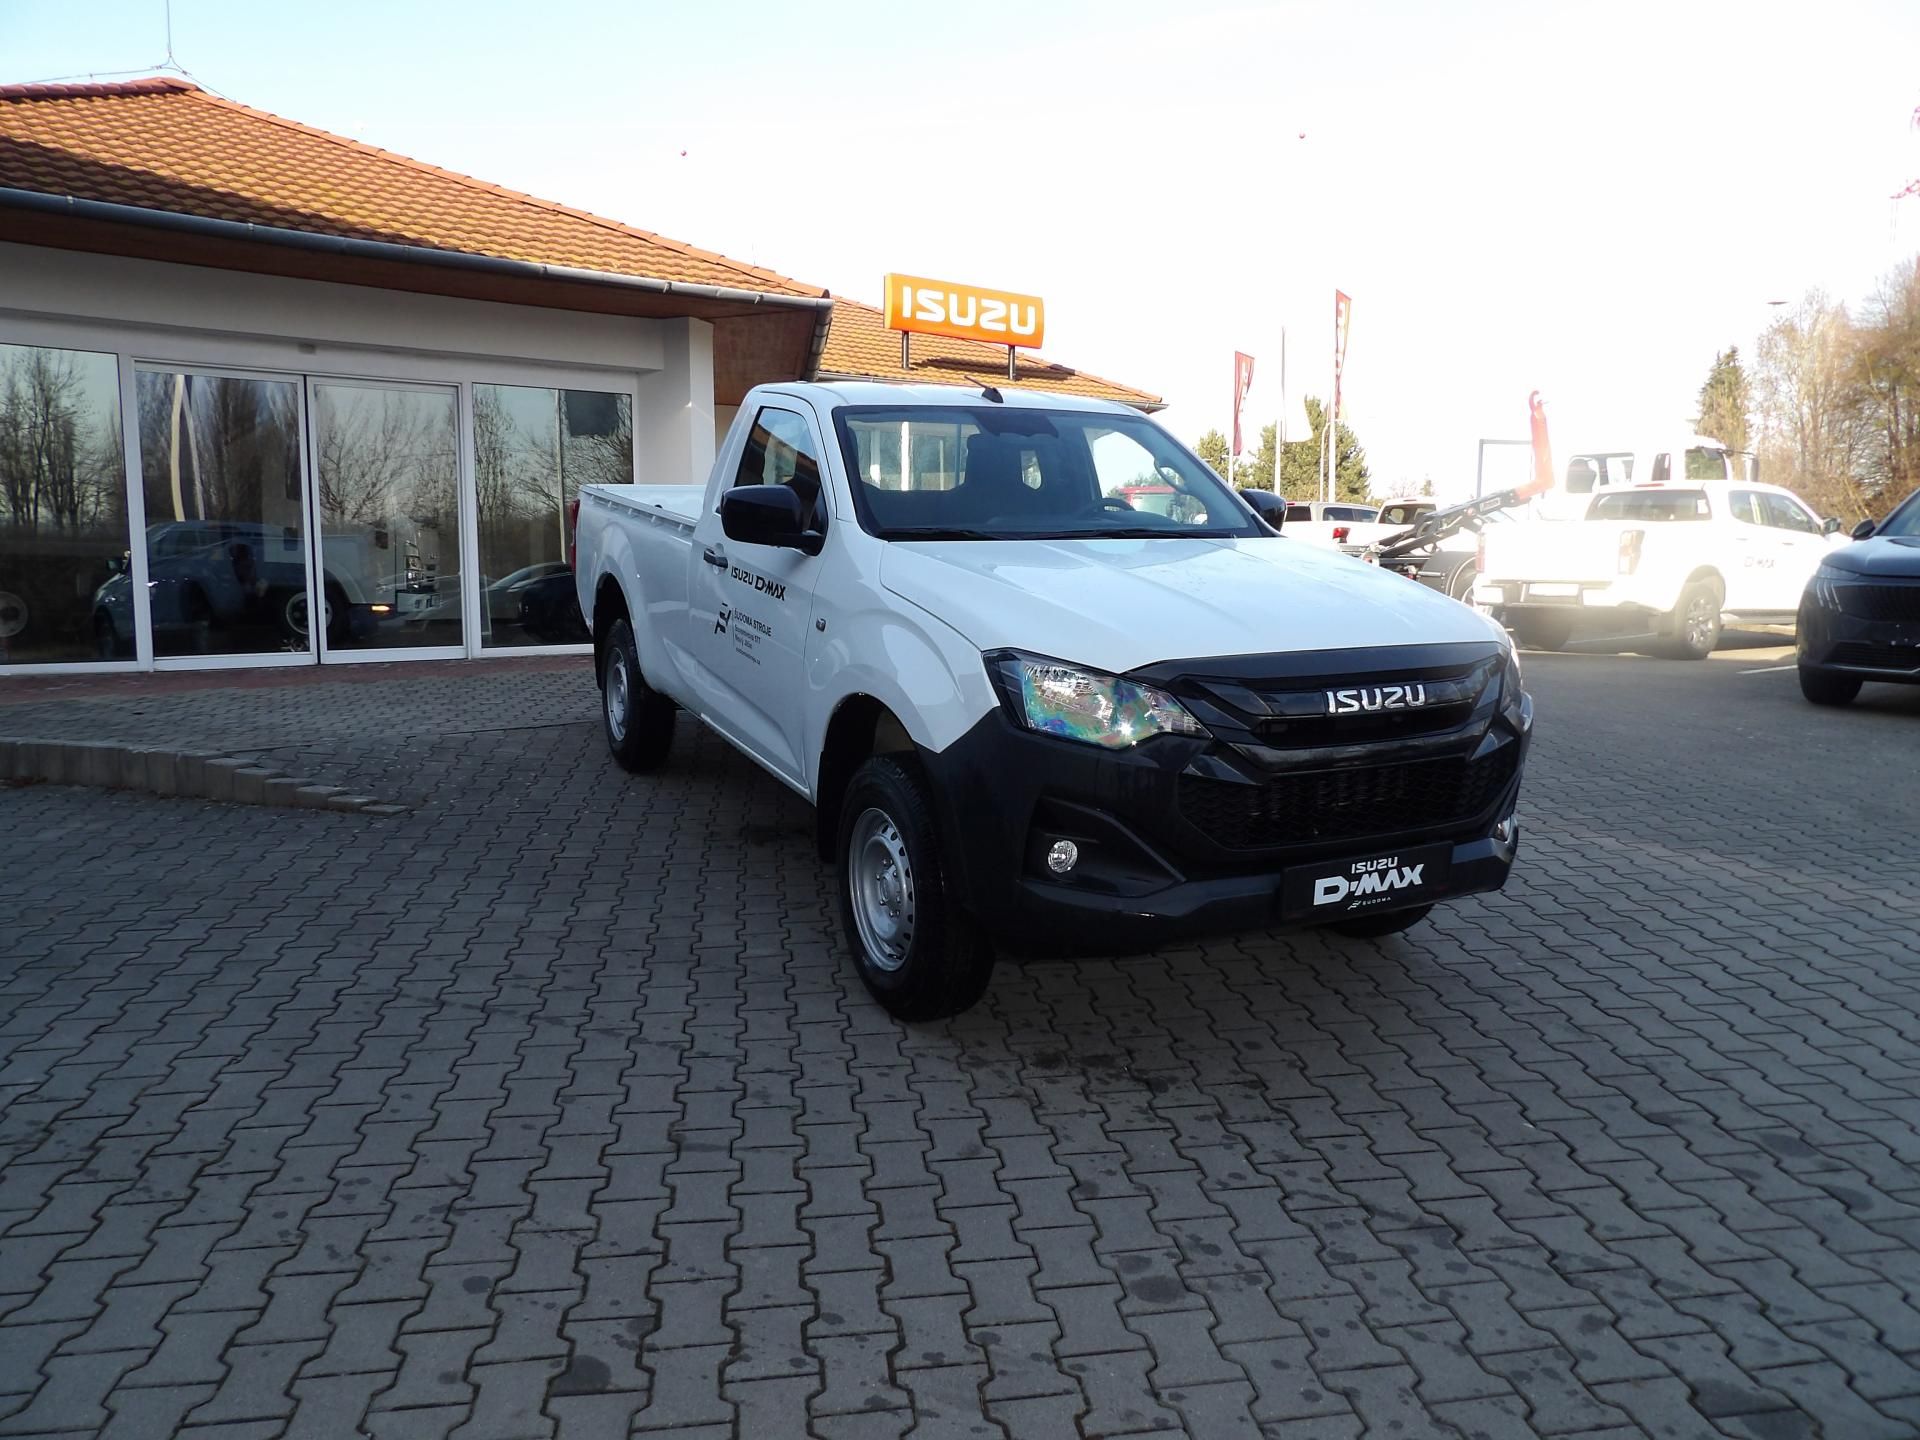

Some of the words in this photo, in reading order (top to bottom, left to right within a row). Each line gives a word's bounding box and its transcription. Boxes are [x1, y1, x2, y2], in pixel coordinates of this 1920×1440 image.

[902, 286, 1036, 336] ISUZU
[731, 565, 754, 586] ISUZU
[754, 575, 786, 601] D-MAX
[1326, 684, 1426, 714] ISUZU
[1351, 856, 1398, 874] ISUZU
[1313, 863, 1425, 905] D-MAX
